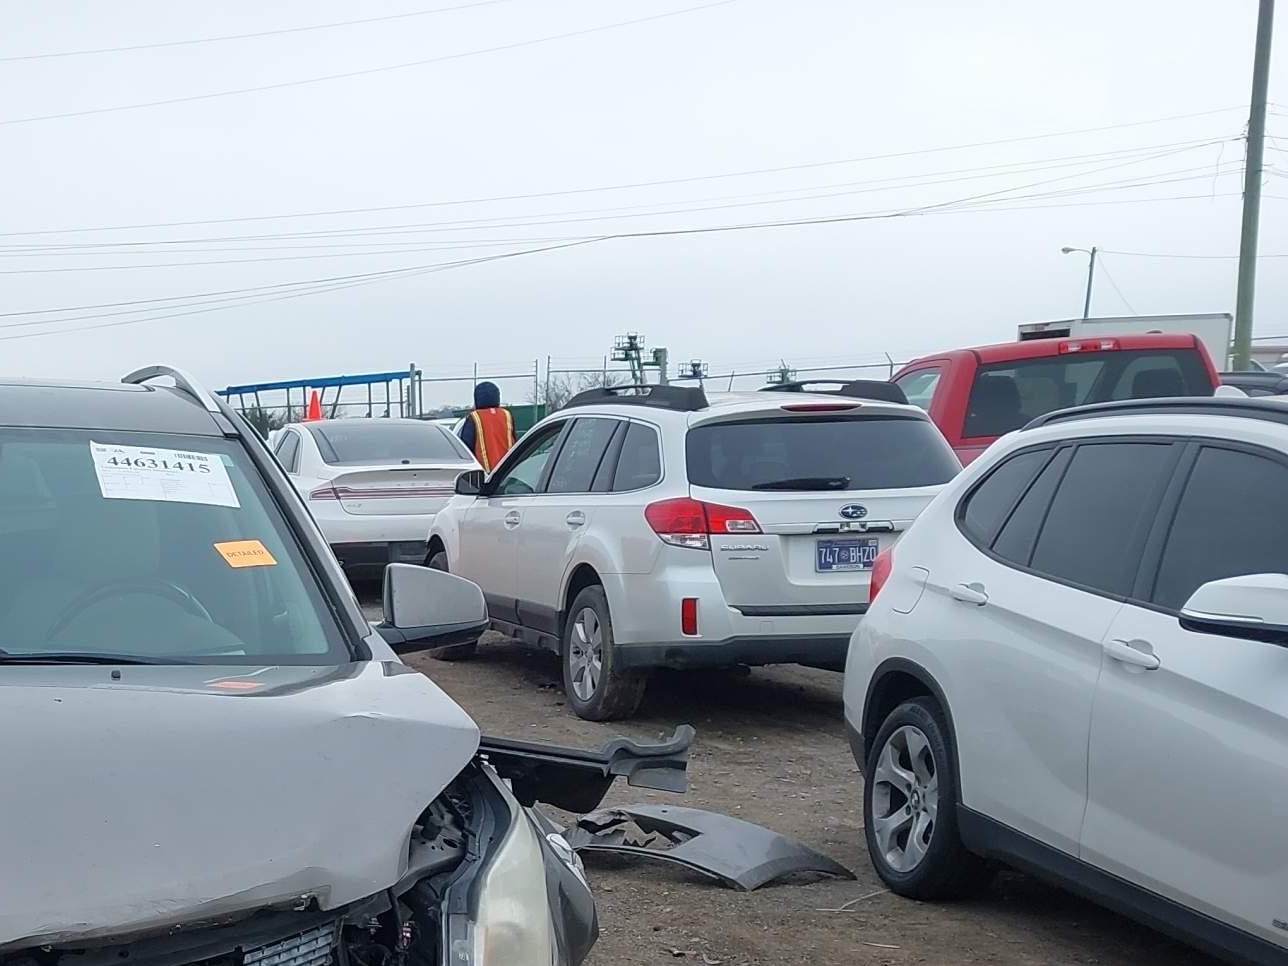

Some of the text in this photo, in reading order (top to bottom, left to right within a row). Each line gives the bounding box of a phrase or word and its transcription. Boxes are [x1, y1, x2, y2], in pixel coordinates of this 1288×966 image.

[107, 457, 211, 474] 44631415
[720, 544, 769, 552] SUBARU
[819, 547, 840, 564] 747
